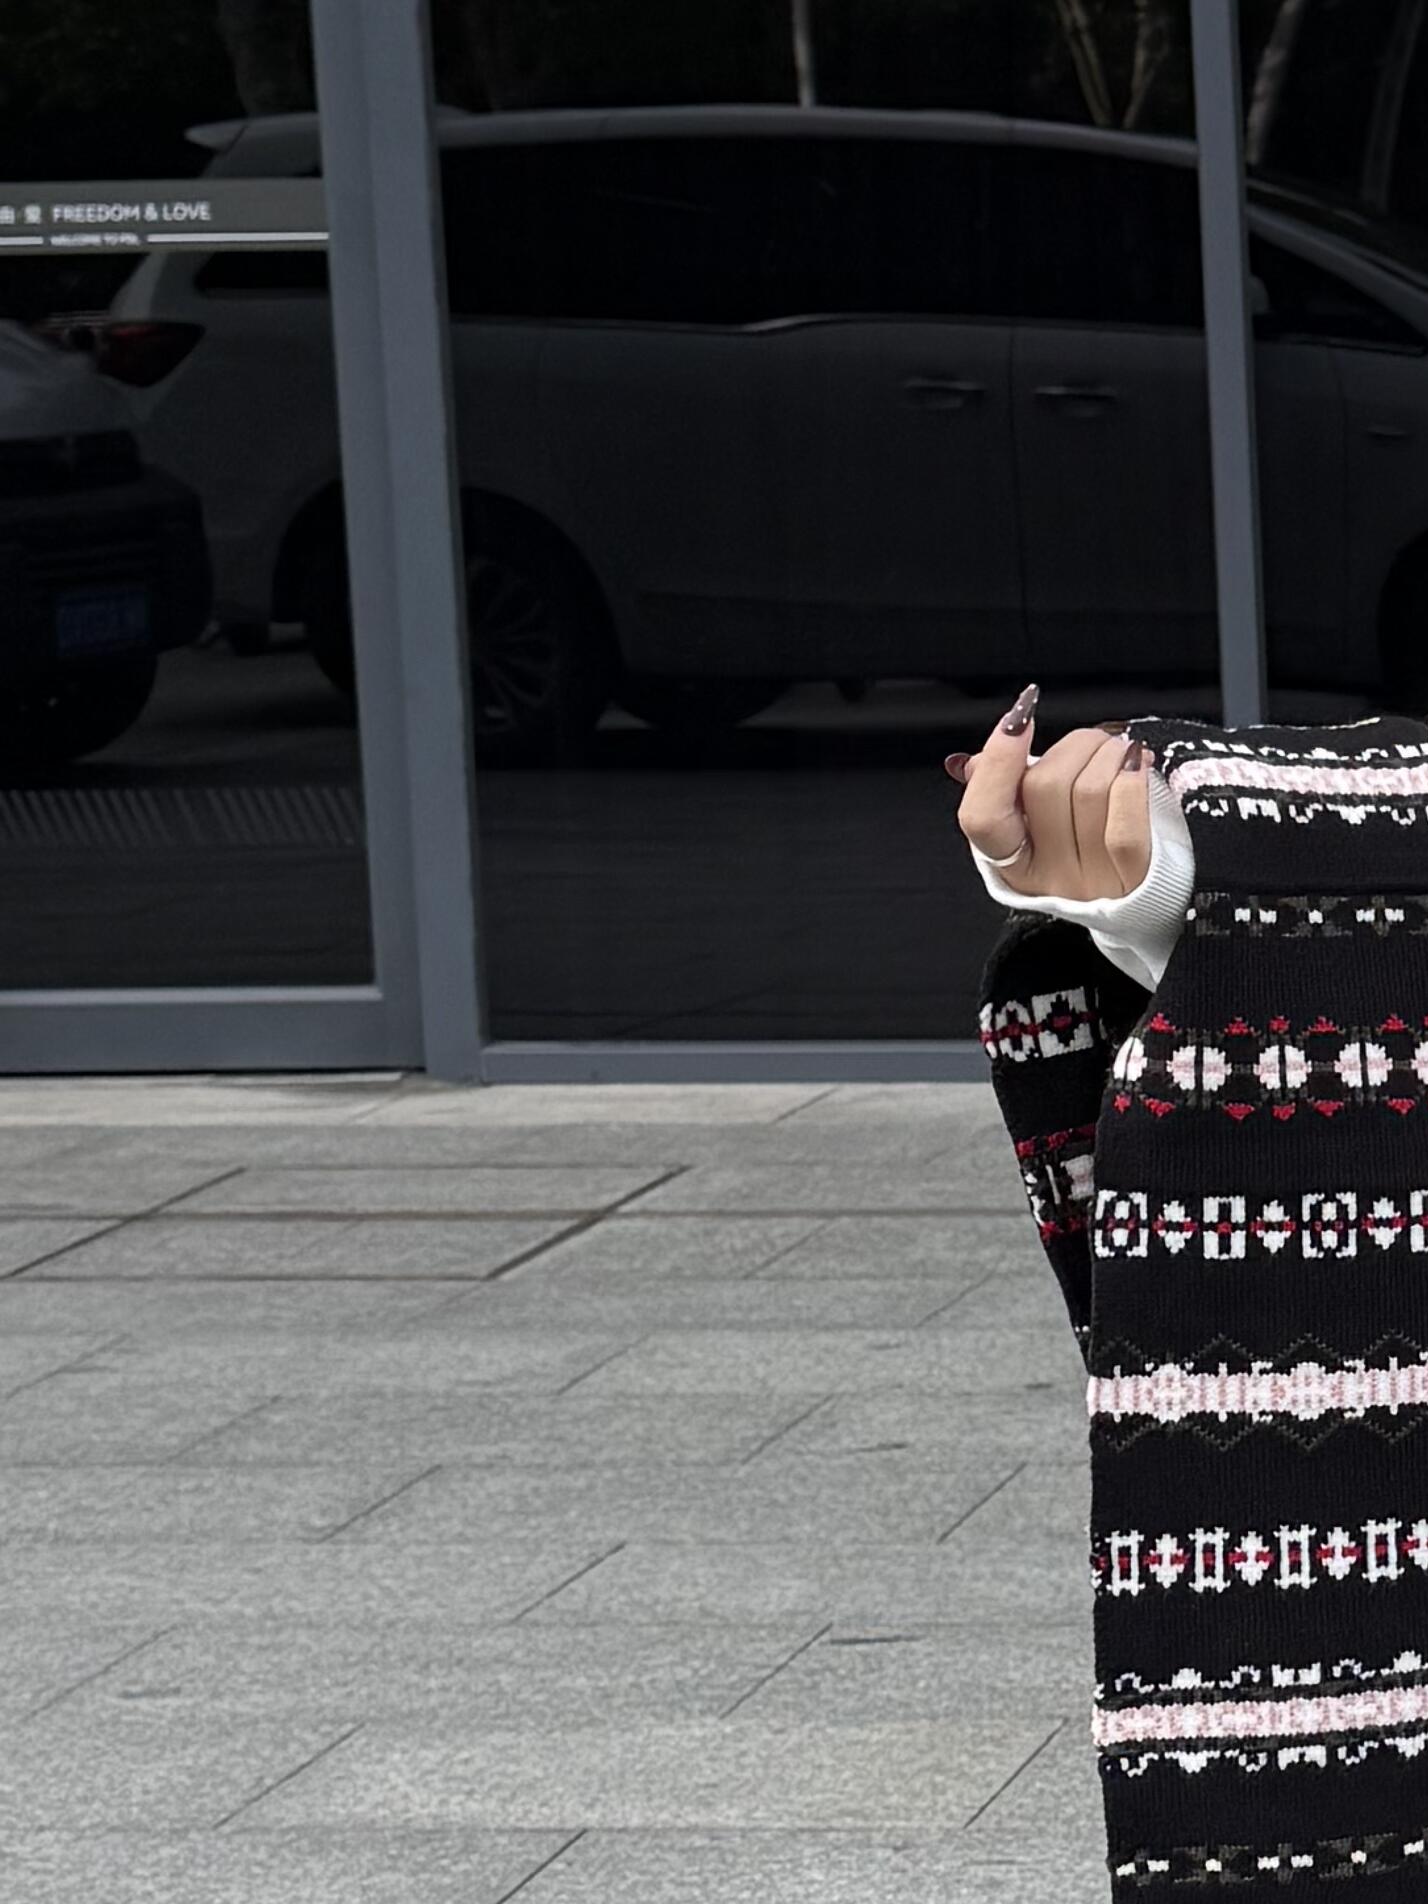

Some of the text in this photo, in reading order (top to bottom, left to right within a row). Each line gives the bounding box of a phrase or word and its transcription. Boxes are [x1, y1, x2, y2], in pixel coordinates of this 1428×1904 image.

[52, 201, 211, 223] FREEDOM & LOVE
